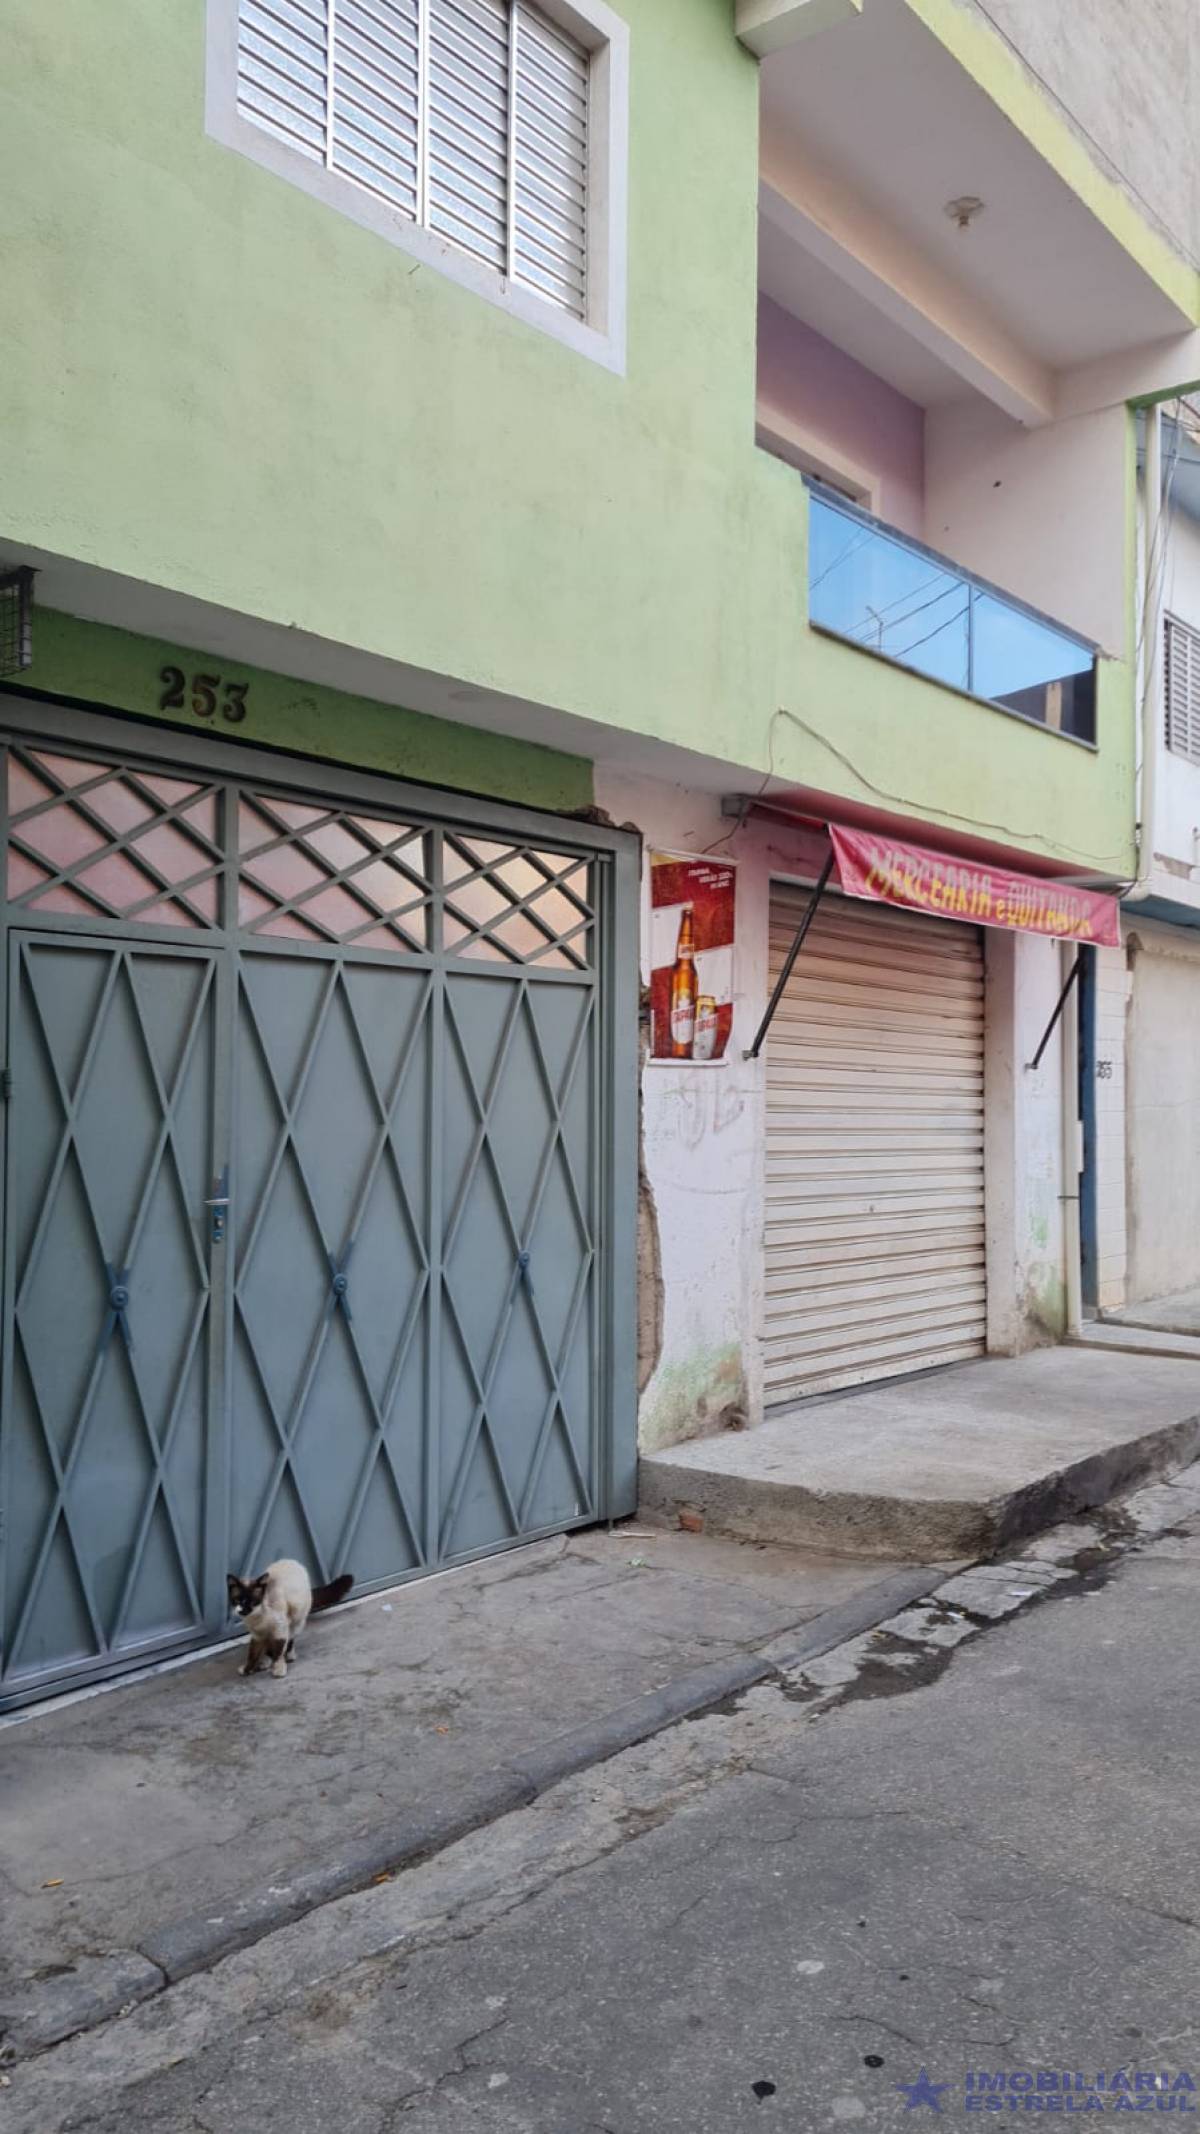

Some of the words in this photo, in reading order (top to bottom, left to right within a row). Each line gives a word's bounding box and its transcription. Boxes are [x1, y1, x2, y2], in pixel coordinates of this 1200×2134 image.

[159, 665, 250, 722] 253
[864, 847, 992, 918] MERCEARIA
[1007, 881, 1094, 938] QUITANDA
